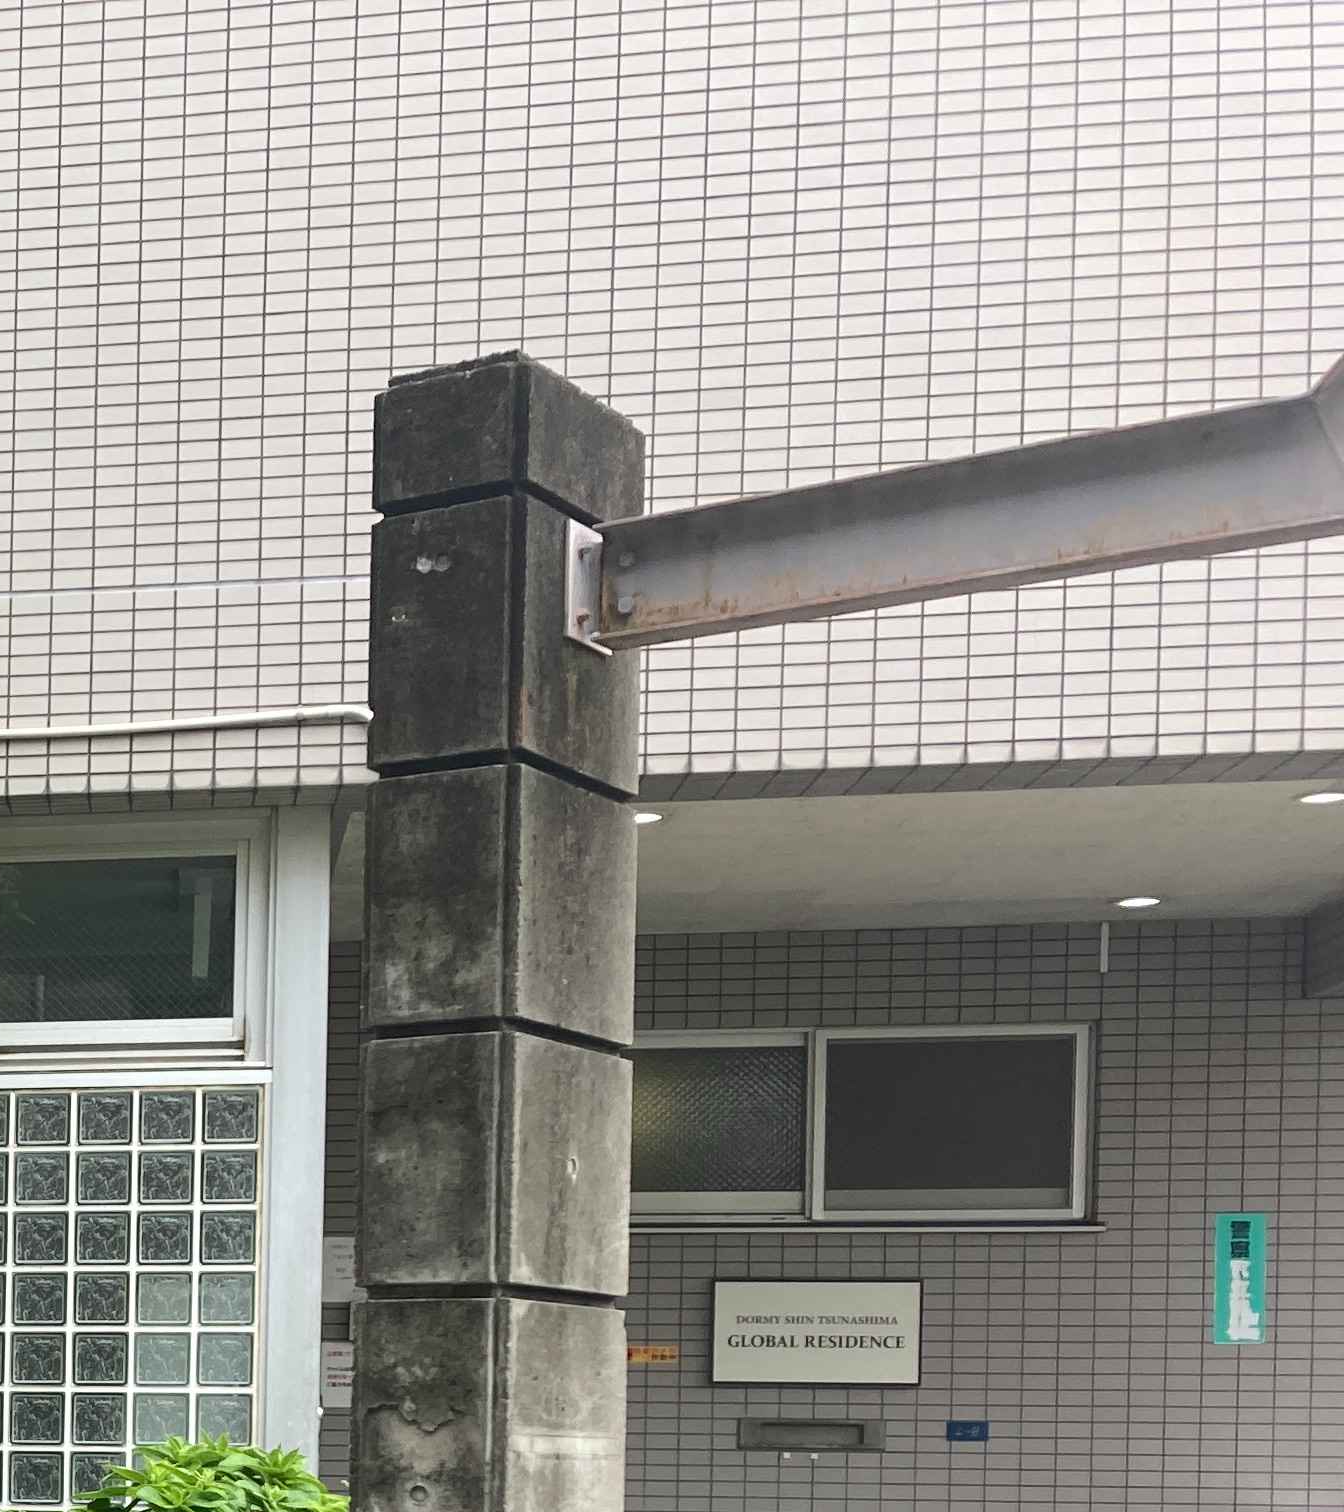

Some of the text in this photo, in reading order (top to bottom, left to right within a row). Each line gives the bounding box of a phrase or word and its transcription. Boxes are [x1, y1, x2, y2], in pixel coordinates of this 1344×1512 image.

[736, 1315, 898, 1325] DORMY SHIN TSUNASHIMA
[727, 1334, 905, 1349] GLOBAL RESIDENCE
